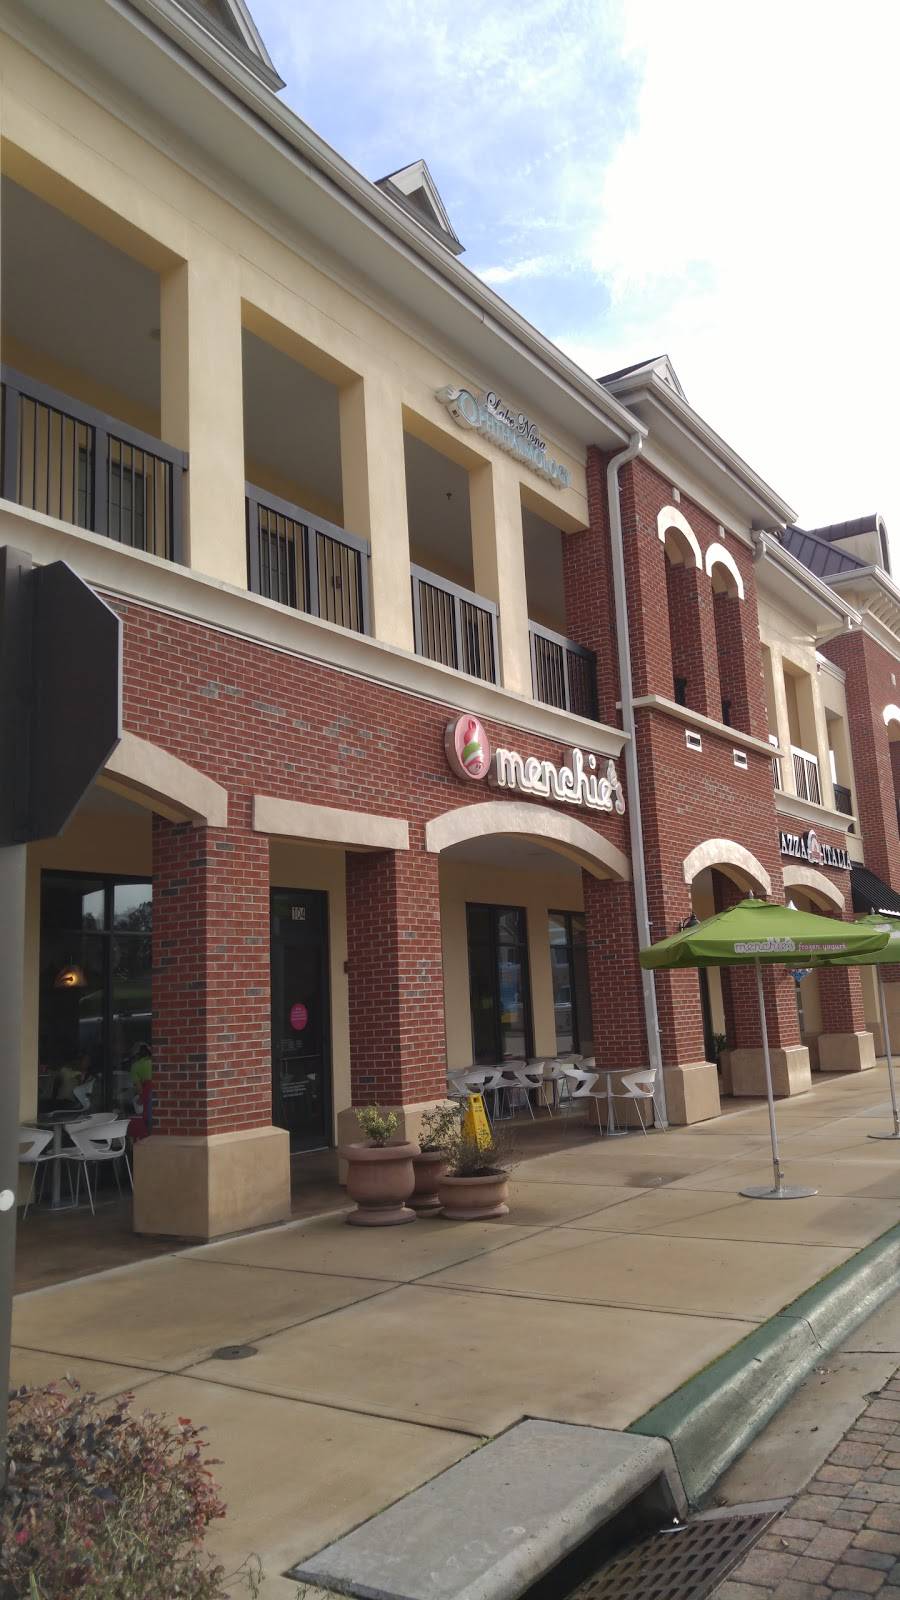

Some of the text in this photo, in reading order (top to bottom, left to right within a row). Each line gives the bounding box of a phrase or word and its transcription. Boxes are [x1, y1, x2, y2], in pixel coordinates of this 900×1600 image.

[485, 391, 546, 453] Lake Nona
[496, 747, 626, 815] menchie's
[291, 906, 306, 921] 104
